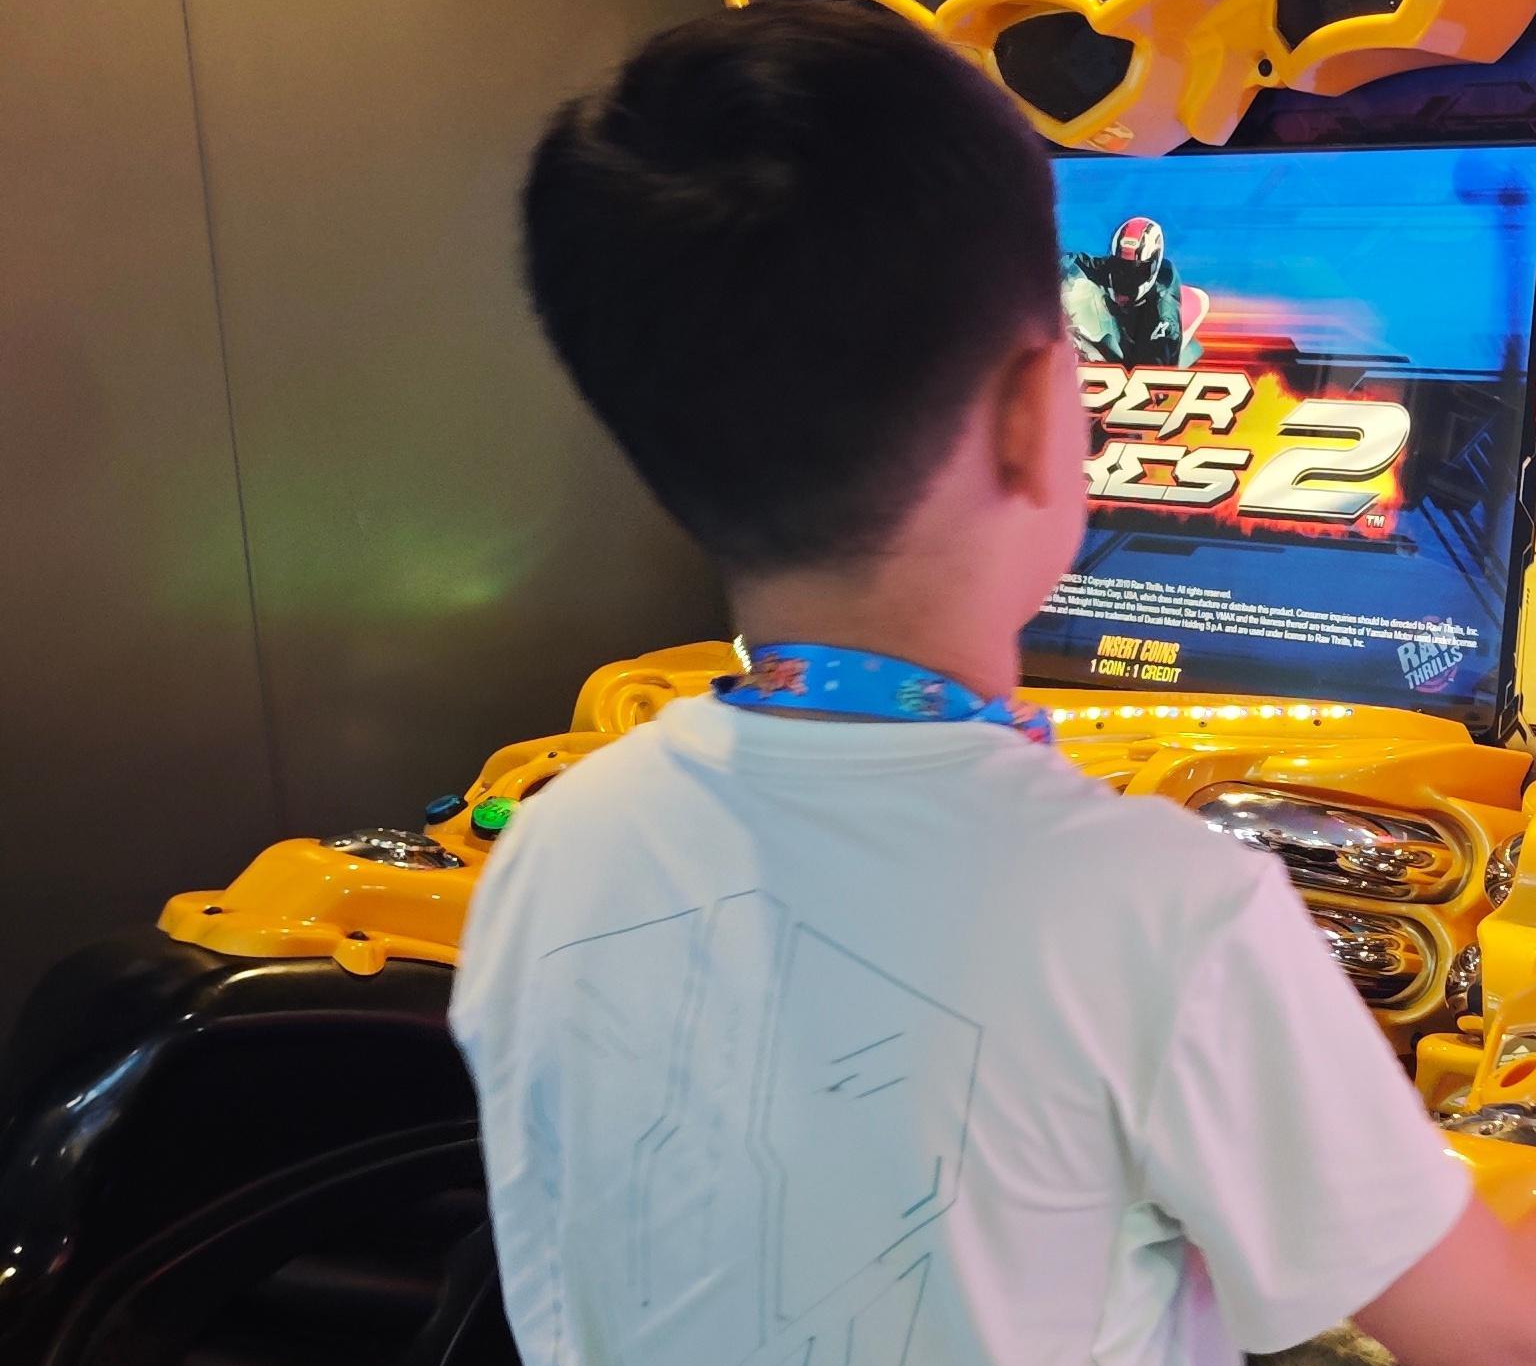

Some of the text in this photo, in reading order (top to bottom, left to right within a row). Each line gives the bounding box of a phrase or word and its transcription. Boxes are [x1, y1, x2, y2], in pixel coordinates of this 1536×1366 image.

[1078, 366, 1253, 440] PER
[1238, 399, 1411, 524] 2
[1091, 659, 1098, 673] 1
[1099, 659, 1125, 677] COIN
[1133, 664, 1140, 678] 1
[1141, 664, 1182, 684] CREDIT
[1097, 635, 1180, 665] INSERT COINS
[1404, 645, 1464, 690] THRILLS
